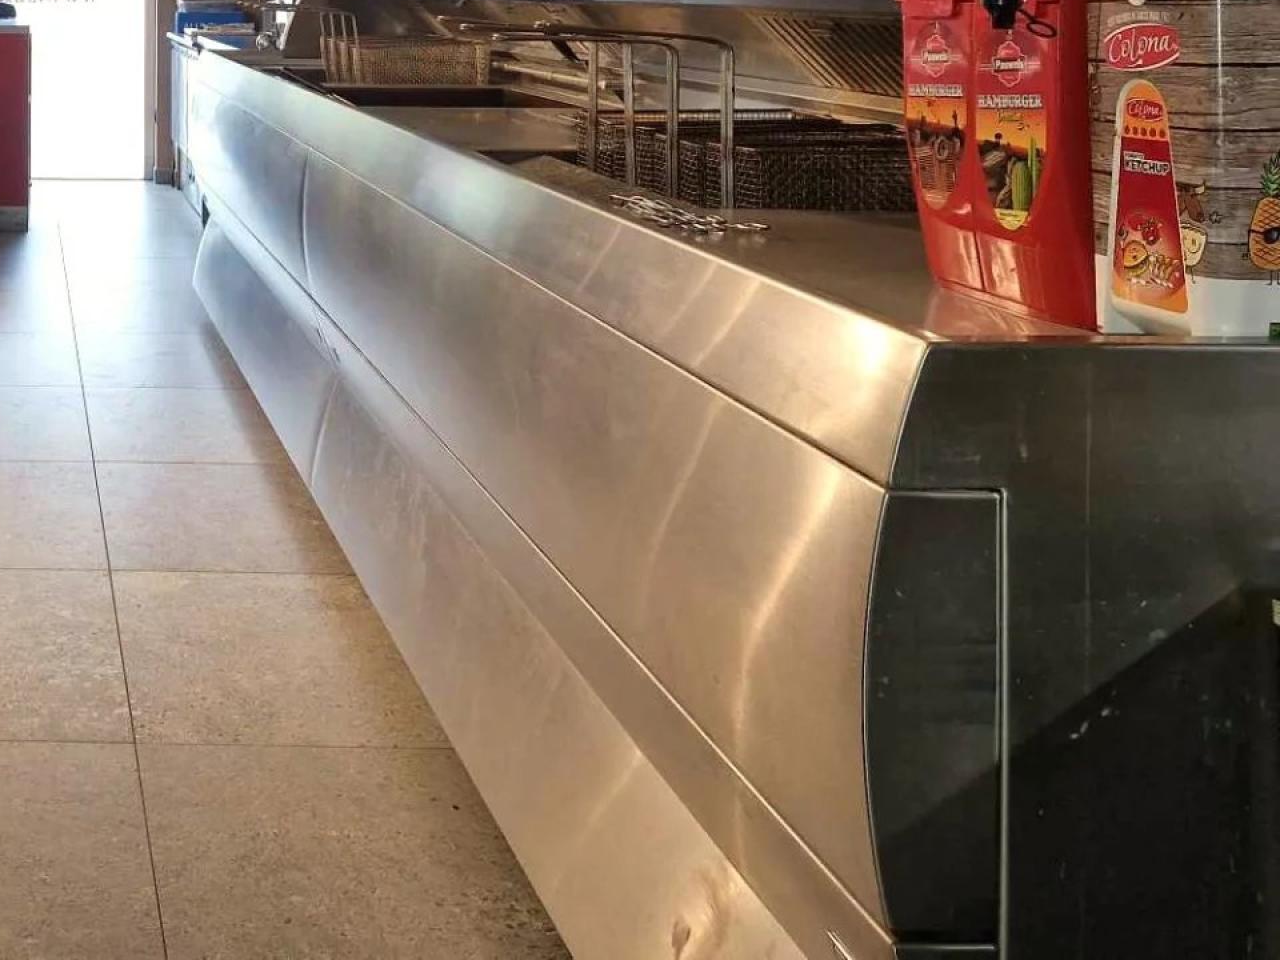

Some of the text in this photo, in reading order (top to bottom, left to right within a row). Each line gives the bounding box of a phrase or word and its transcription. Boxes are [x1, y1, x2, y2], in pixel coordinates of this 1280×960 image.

[1109, 28, 1170, 62] Colona
[908, 84, 964, 97] HAMBURGER
[976, 95, 1042, 109] HAMBURGER
[1125, 159, 1169, 174] KETCHUP
